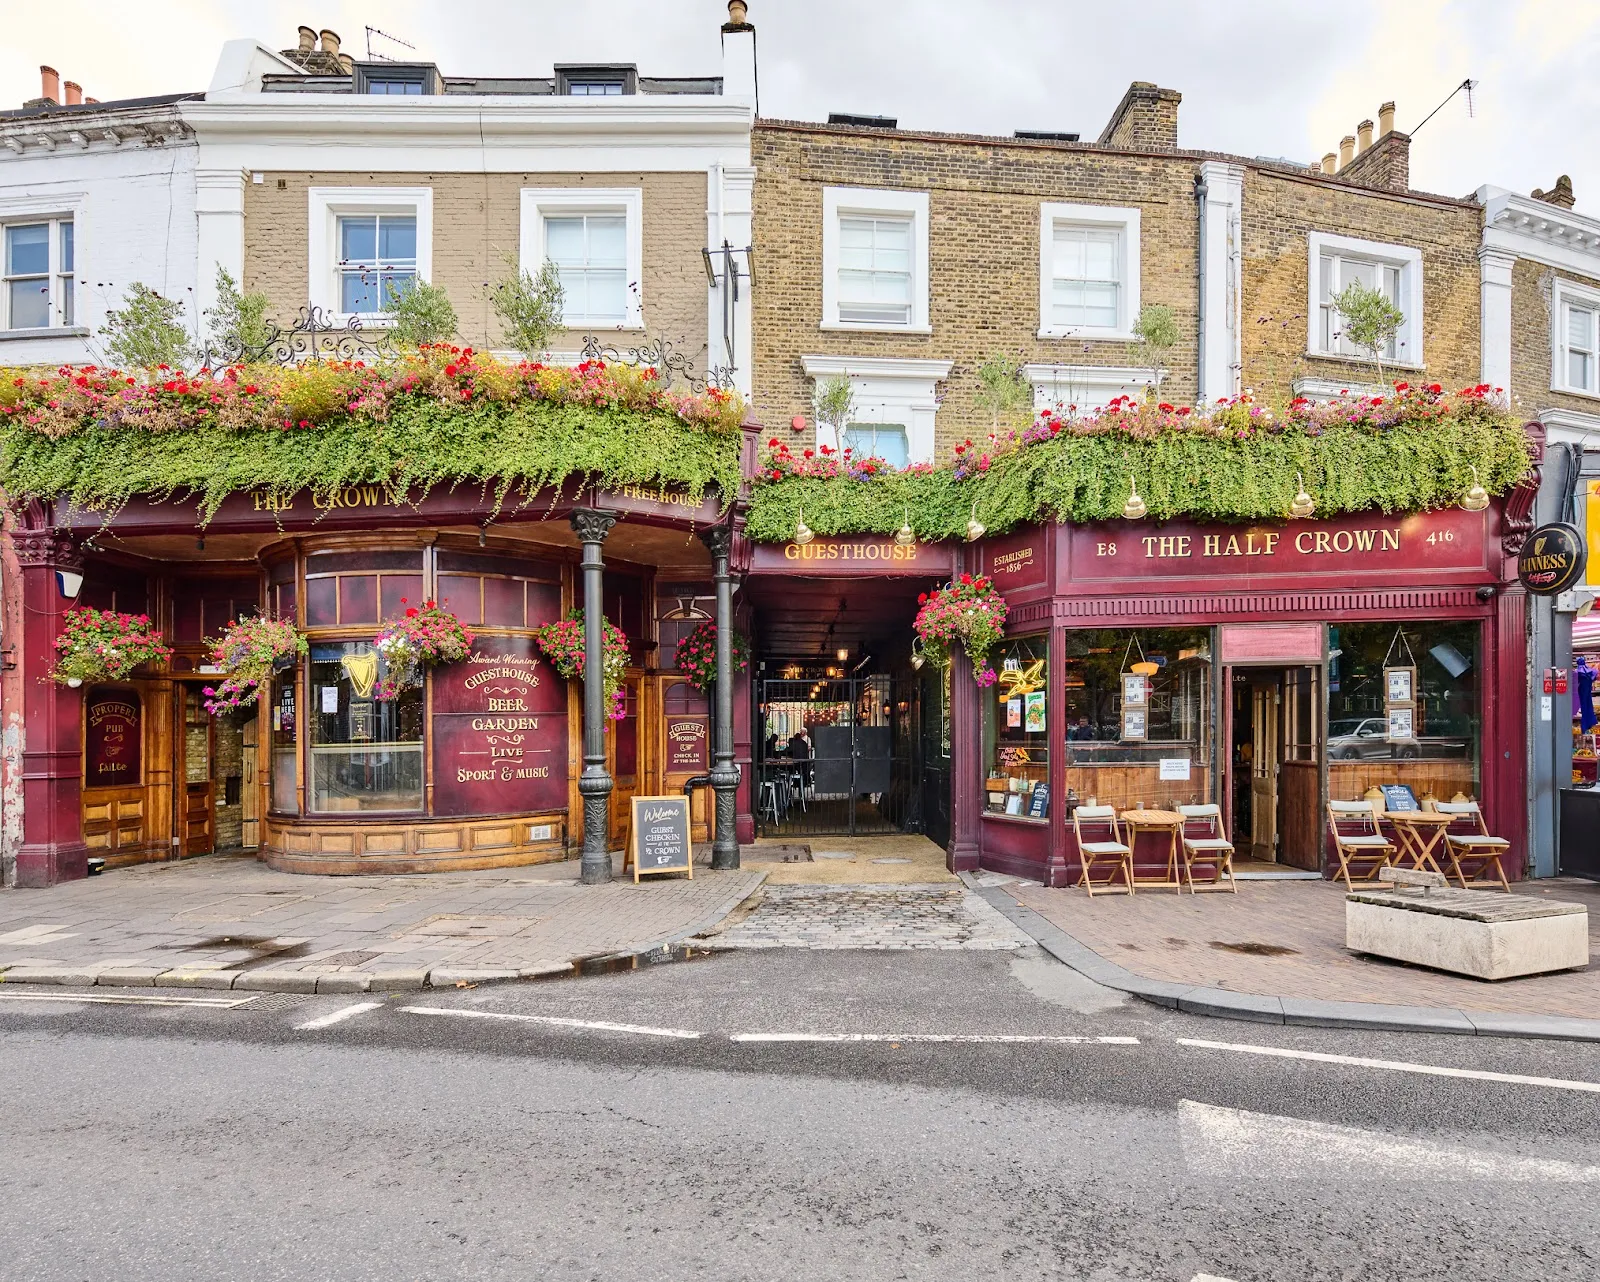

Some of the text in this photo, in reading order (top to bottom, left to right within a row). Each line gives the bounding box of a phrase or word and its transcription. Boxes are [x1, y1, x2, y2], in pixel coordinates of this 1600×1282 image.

[251, 486, 398, 511] THE CROWN
[623, 484, 704, 509] FREE HOUSE
[1096, 528, 1454, 558] E8 THE HALF CROWN 416
[784, 543, 917, 560] GUESTHOUSE
[994, 547, 1033, 566] ESTABLISHED
[1006, 561, 1022, 573] 1856
[467, 651, 540, 670] Award Winning
[464, 667, 540, 690] GUESTHOUSE
[281, 697, 294, 706] LIVE
[281, 705, 295, 713] HERE
[487, 697, 529, 712] BEER
[94, 704, 131, 716] PROPER
[106, 724, 124, 733] PUB
[472, 717, 539, 733] GARDEN
[674, 724, 700, 733] GUEST
[490, 746, 524, 757] LIVE
[457, 766, 549, 783] SPORT & MUSIC
[643, 806, 680, 823] Welcome
[650, 826, 674, 834] GUEST
[654, 846, 681, 855] CROWN
